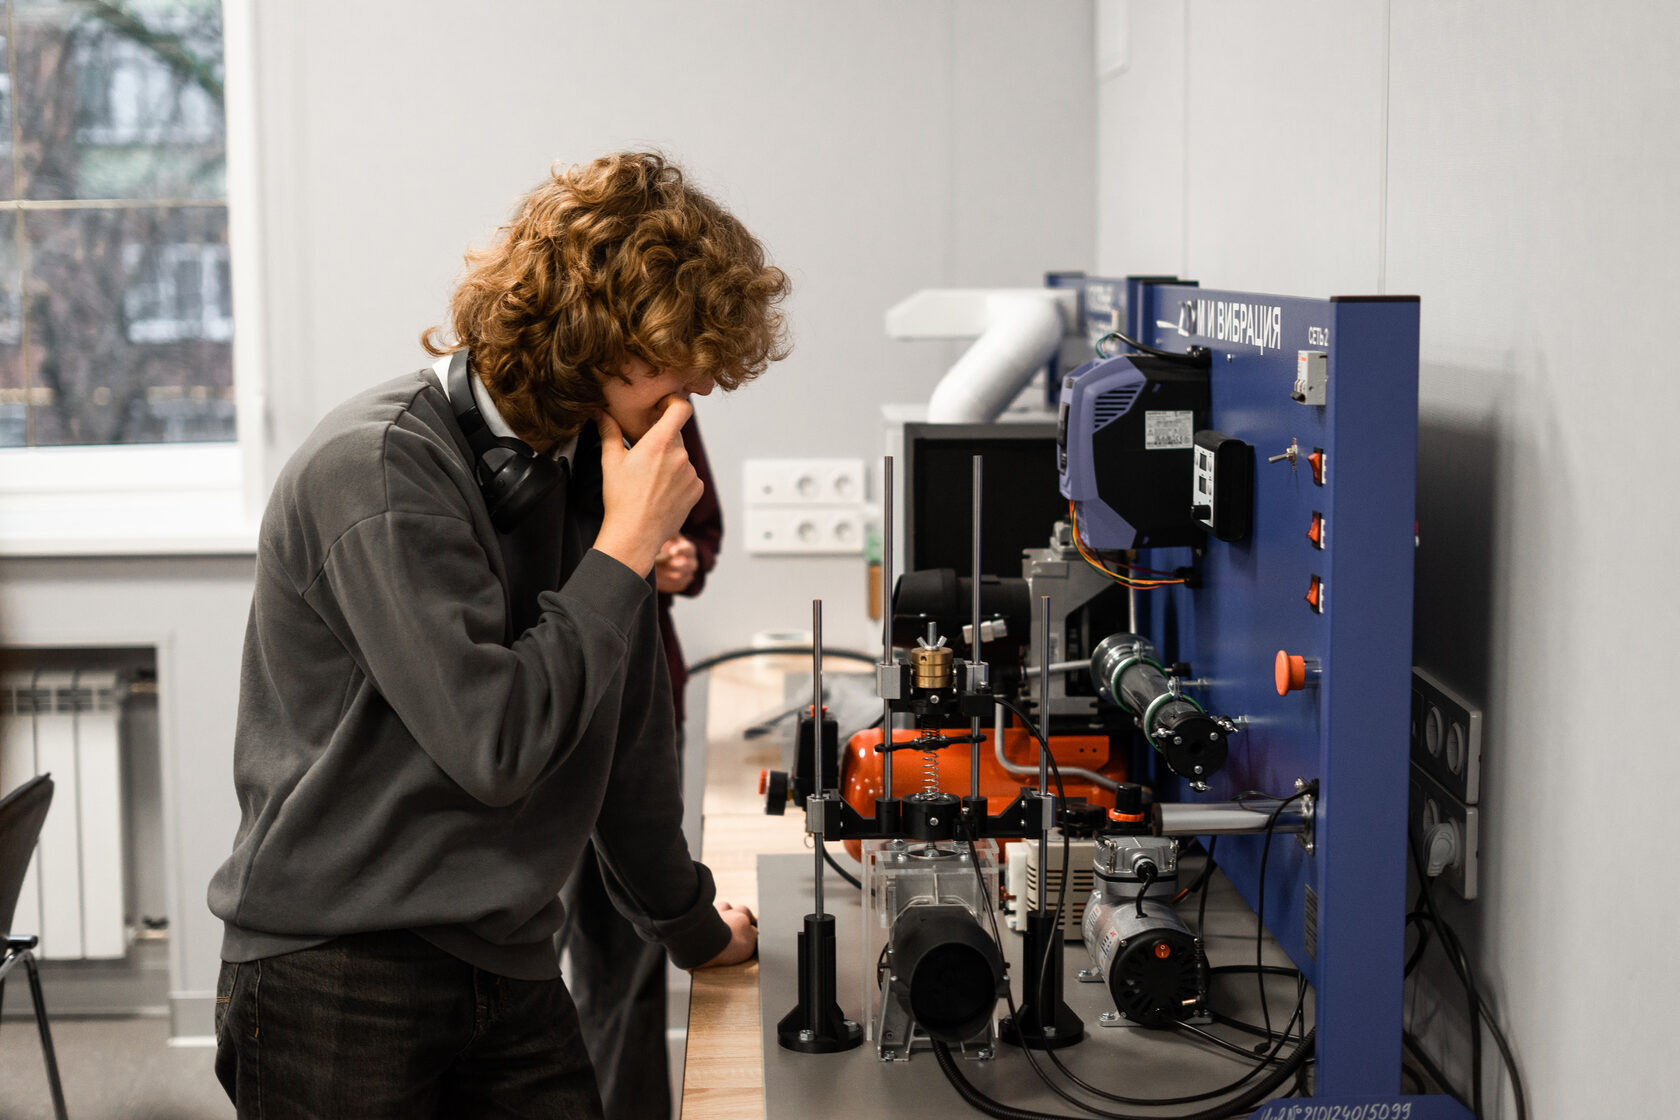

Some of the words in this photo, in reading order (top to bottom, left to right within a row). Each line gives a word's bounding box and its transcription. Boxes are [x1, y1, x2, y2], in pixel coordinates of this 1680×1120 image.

[1208, 300, 1215, 339] И
[1217, 301, 1281, 356] ВИБРАЦИЯ
[1309, 326, 1323, 346] СЕТЬ
